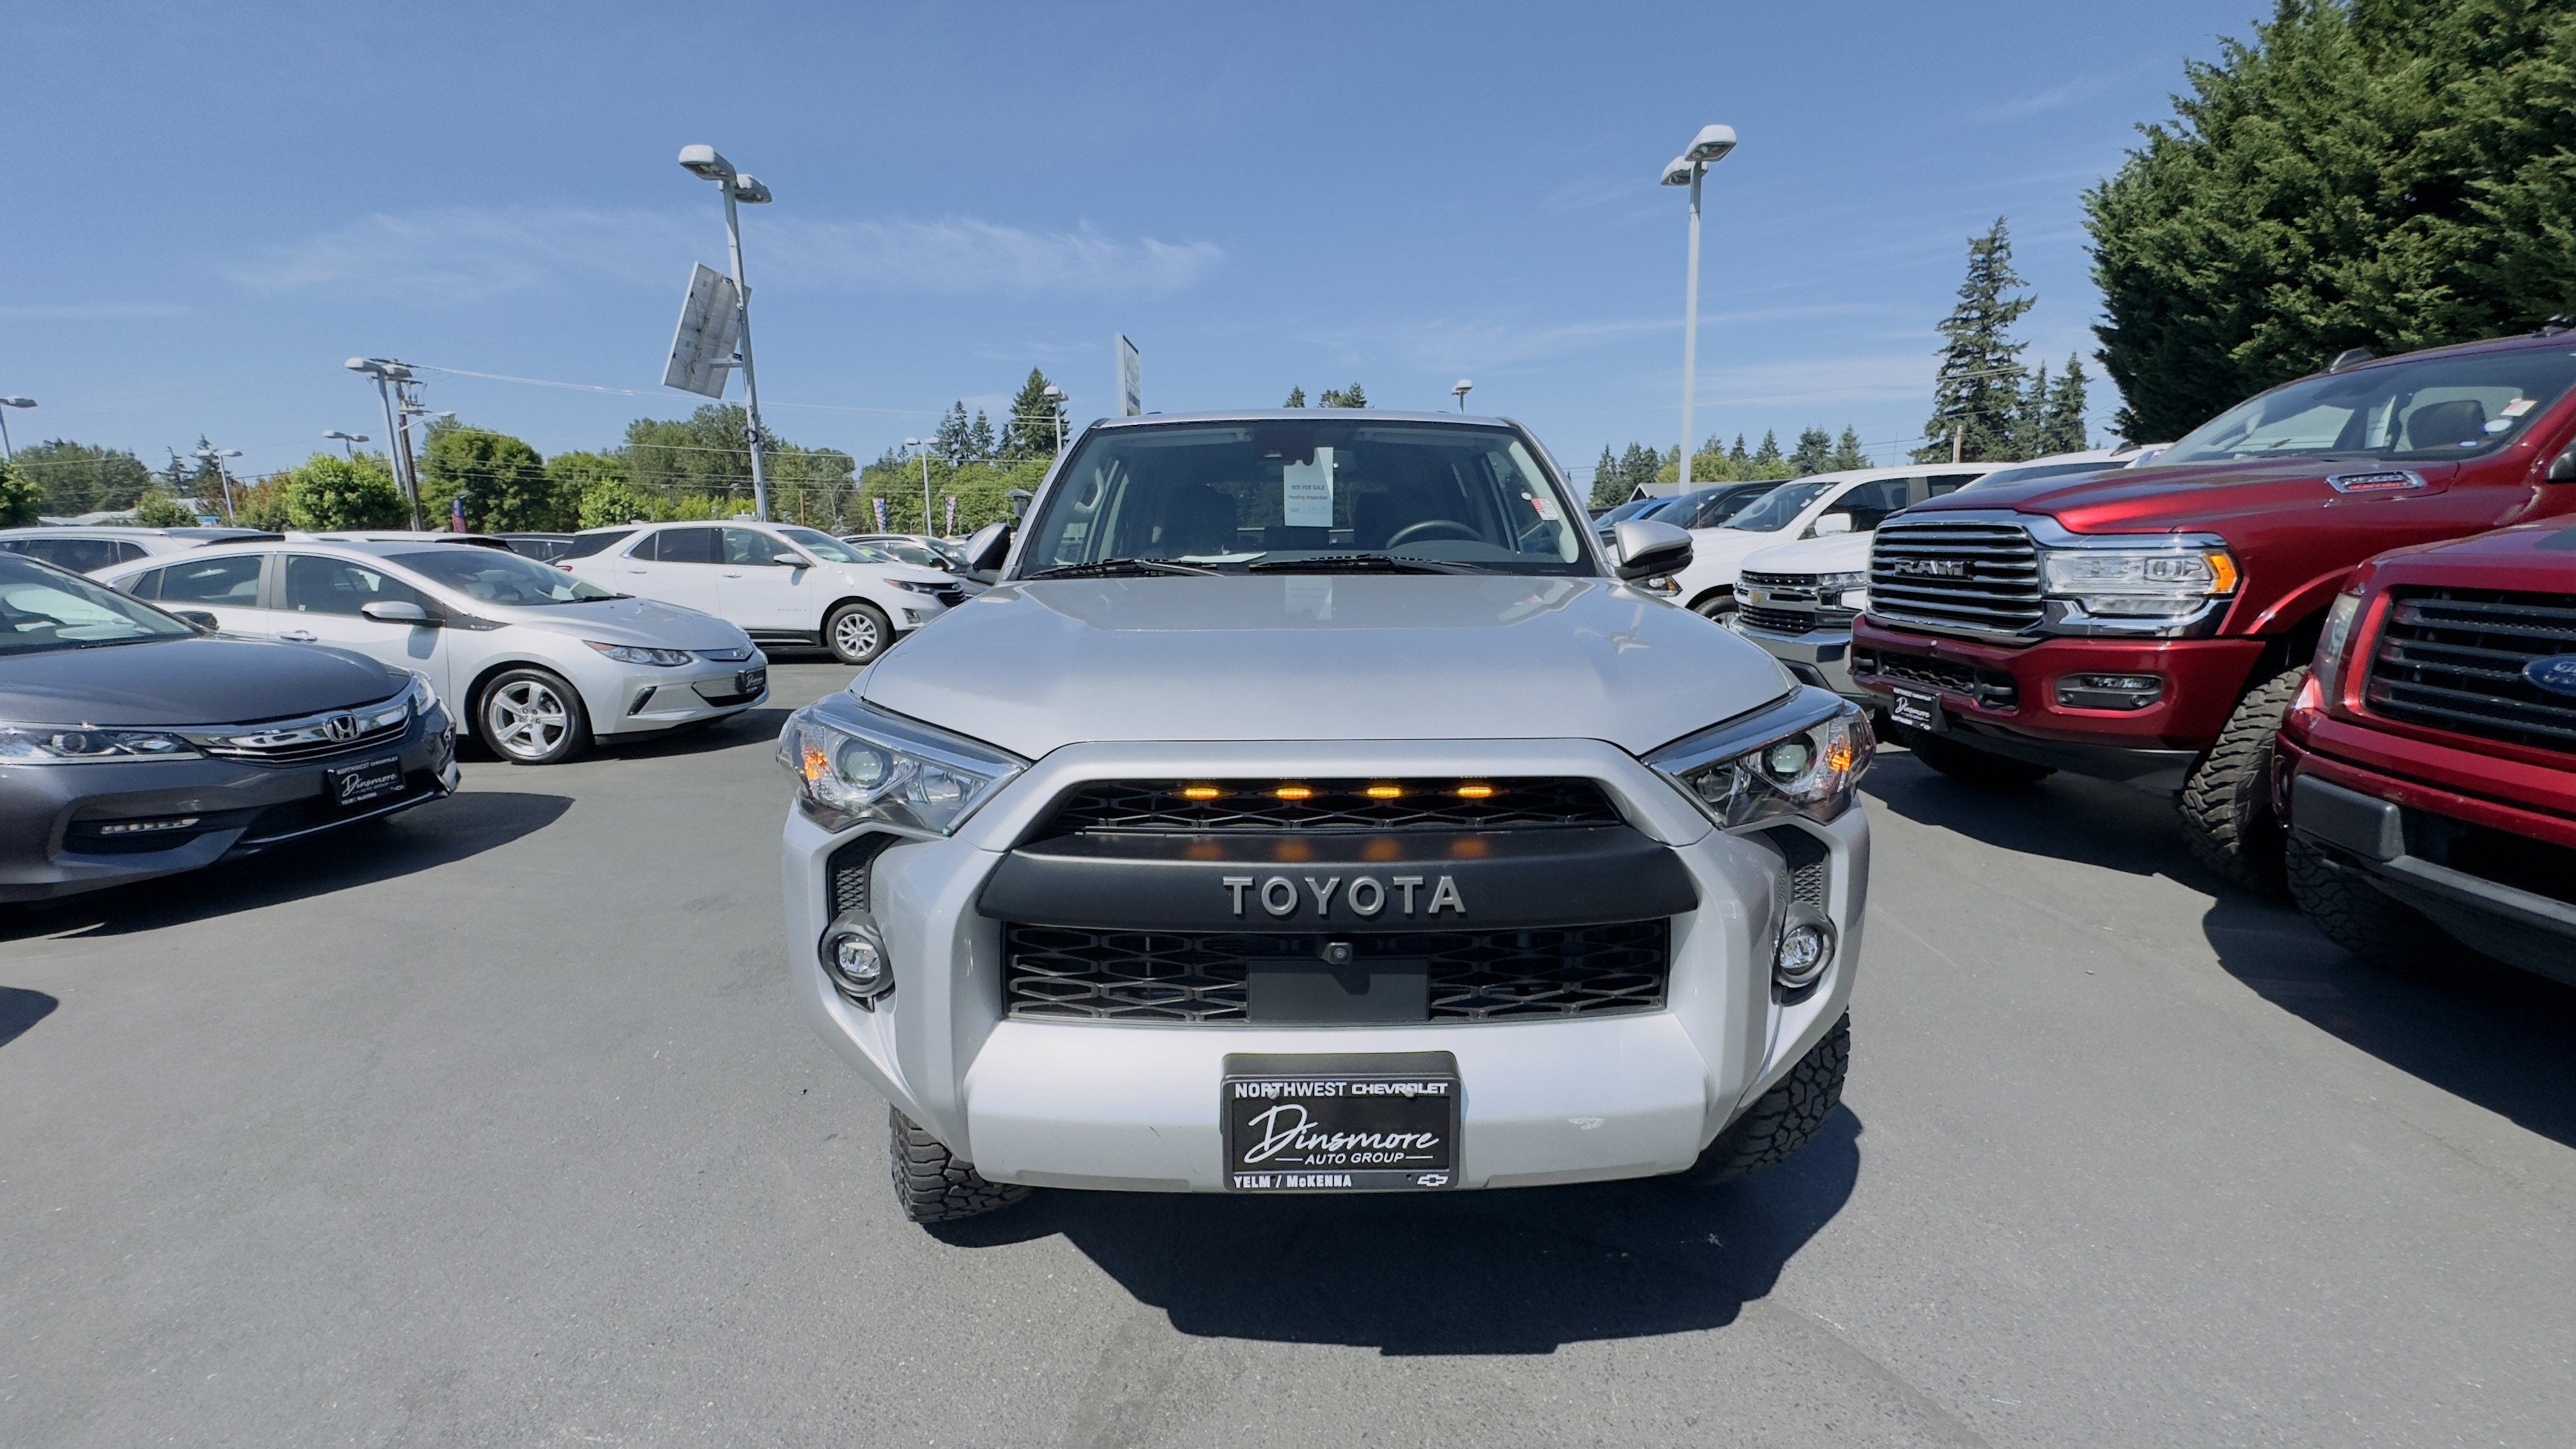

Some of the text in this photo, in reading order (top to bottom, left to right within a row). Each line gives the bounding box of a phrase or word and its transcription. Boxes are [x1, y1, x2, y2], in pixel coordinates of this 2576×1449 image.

[1894, 559, 1964, 576] RAM
[1222, 875, 1466, 916] TOYOTA
[1235, 1082, 1448, 1098] NORTHWEST CHEVROLET
[1243, 1103, 1440, 1164] Dinsmore
[1304, 1151, 1405, 1165] AUTO GROUP
[1233, 1175, 1271, 1188] YELM
[1286, 1174, 1352, 1188] McKENNA
